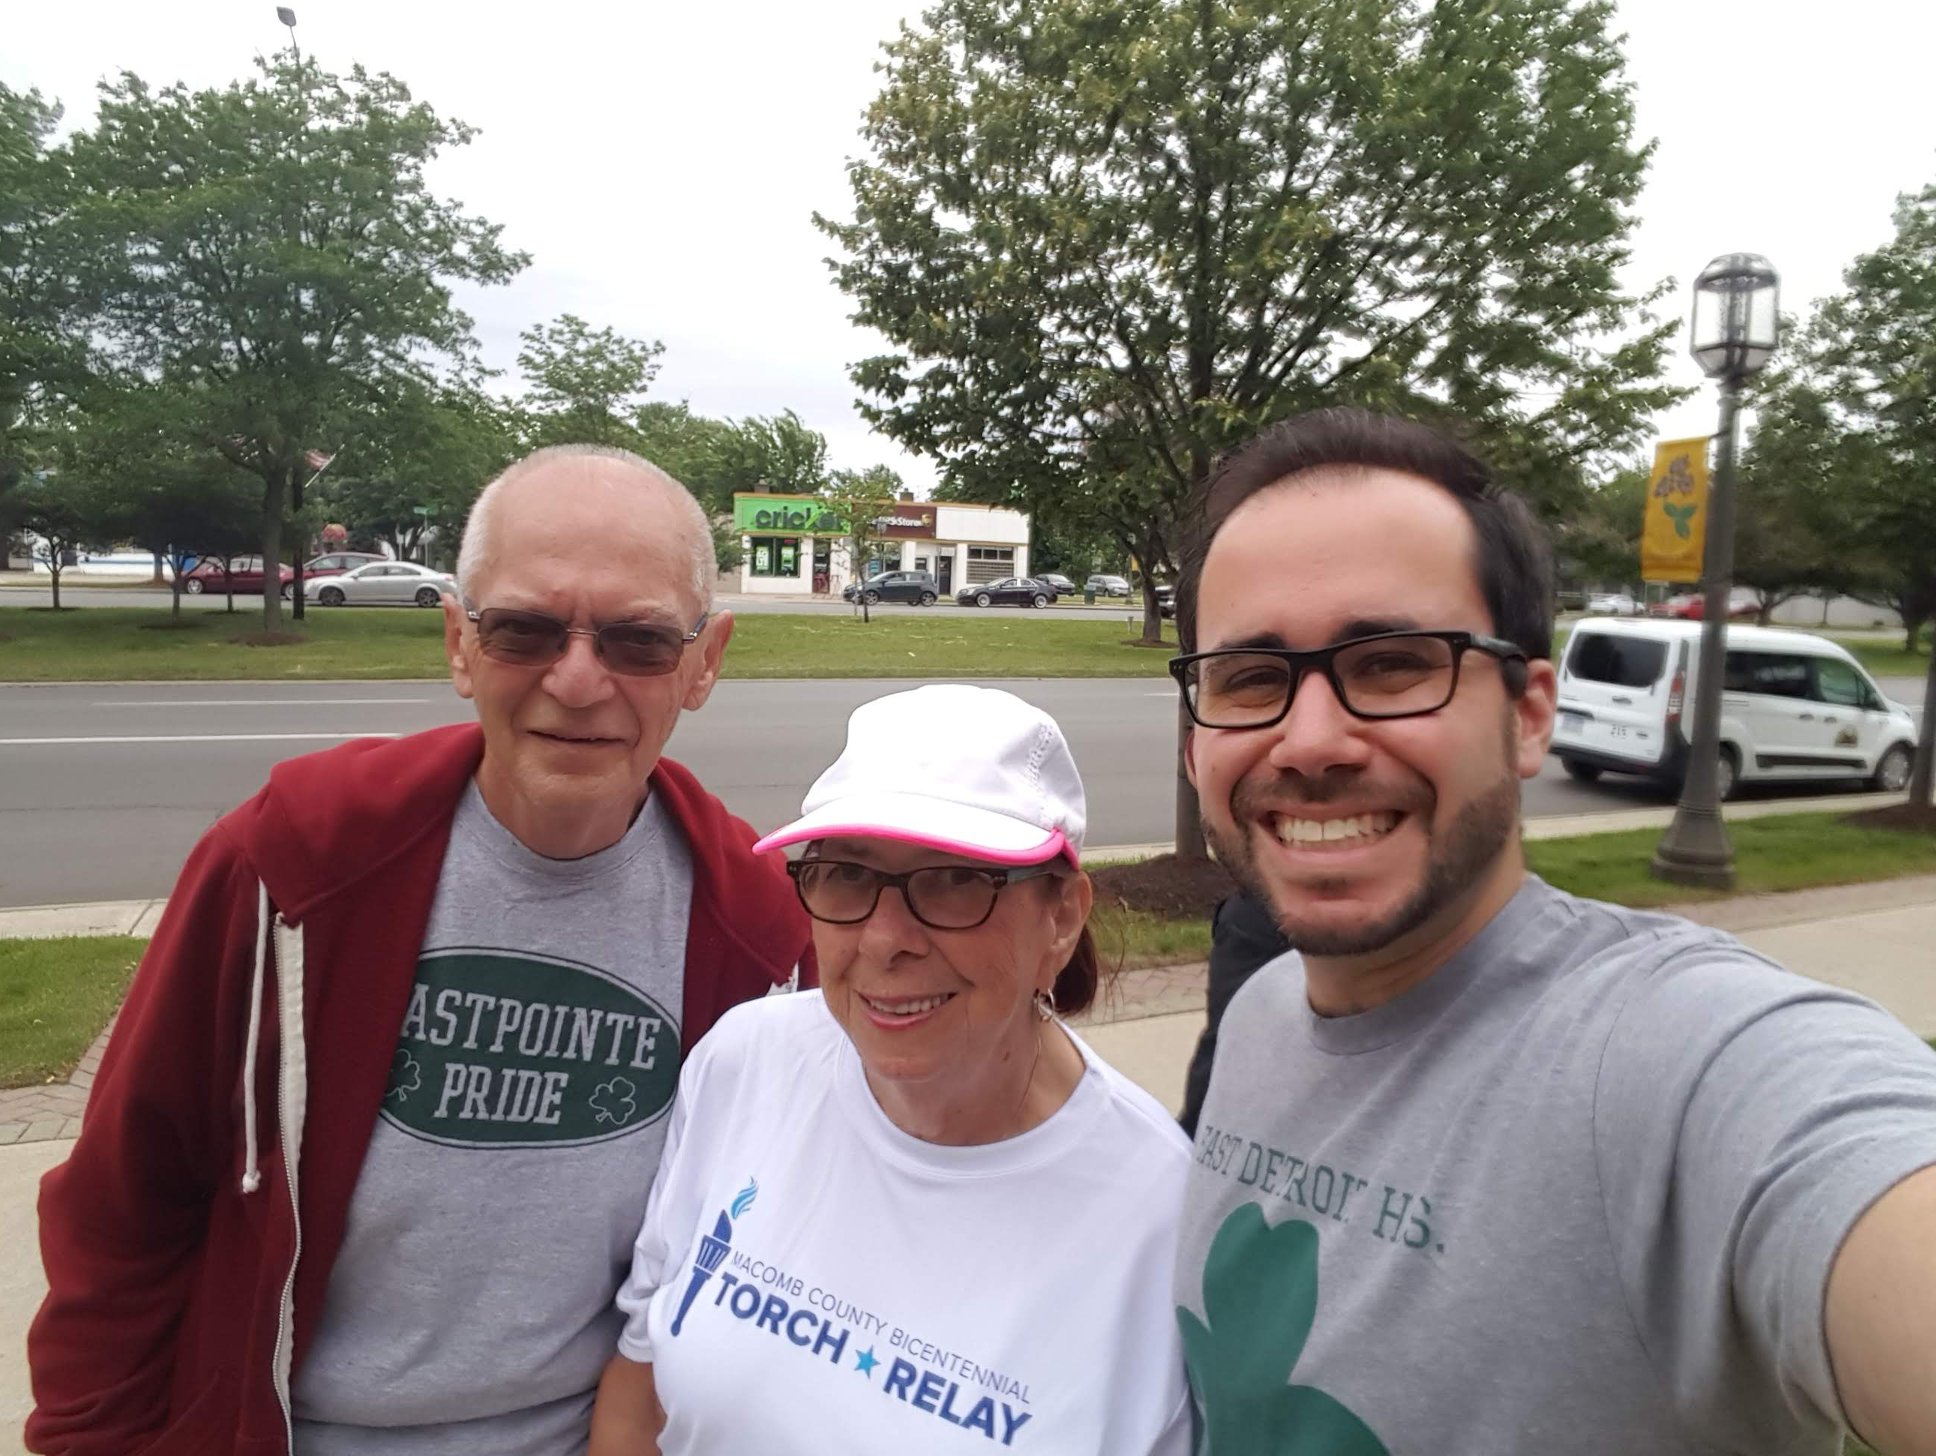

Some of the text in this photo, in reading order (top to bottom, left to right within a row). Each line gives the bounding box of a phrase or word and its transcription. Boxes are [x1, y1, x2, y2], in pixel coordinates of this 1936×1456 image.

[402, 983, 661, 1070] ASTPOINTE
[433, 1062, 569, 1125] PRIDE
[714, 1272, 1033, 1446] TORCH RELAY
[732, 1251, 1030, 1404] MACOMB COUNTY BICENTENNIAL
